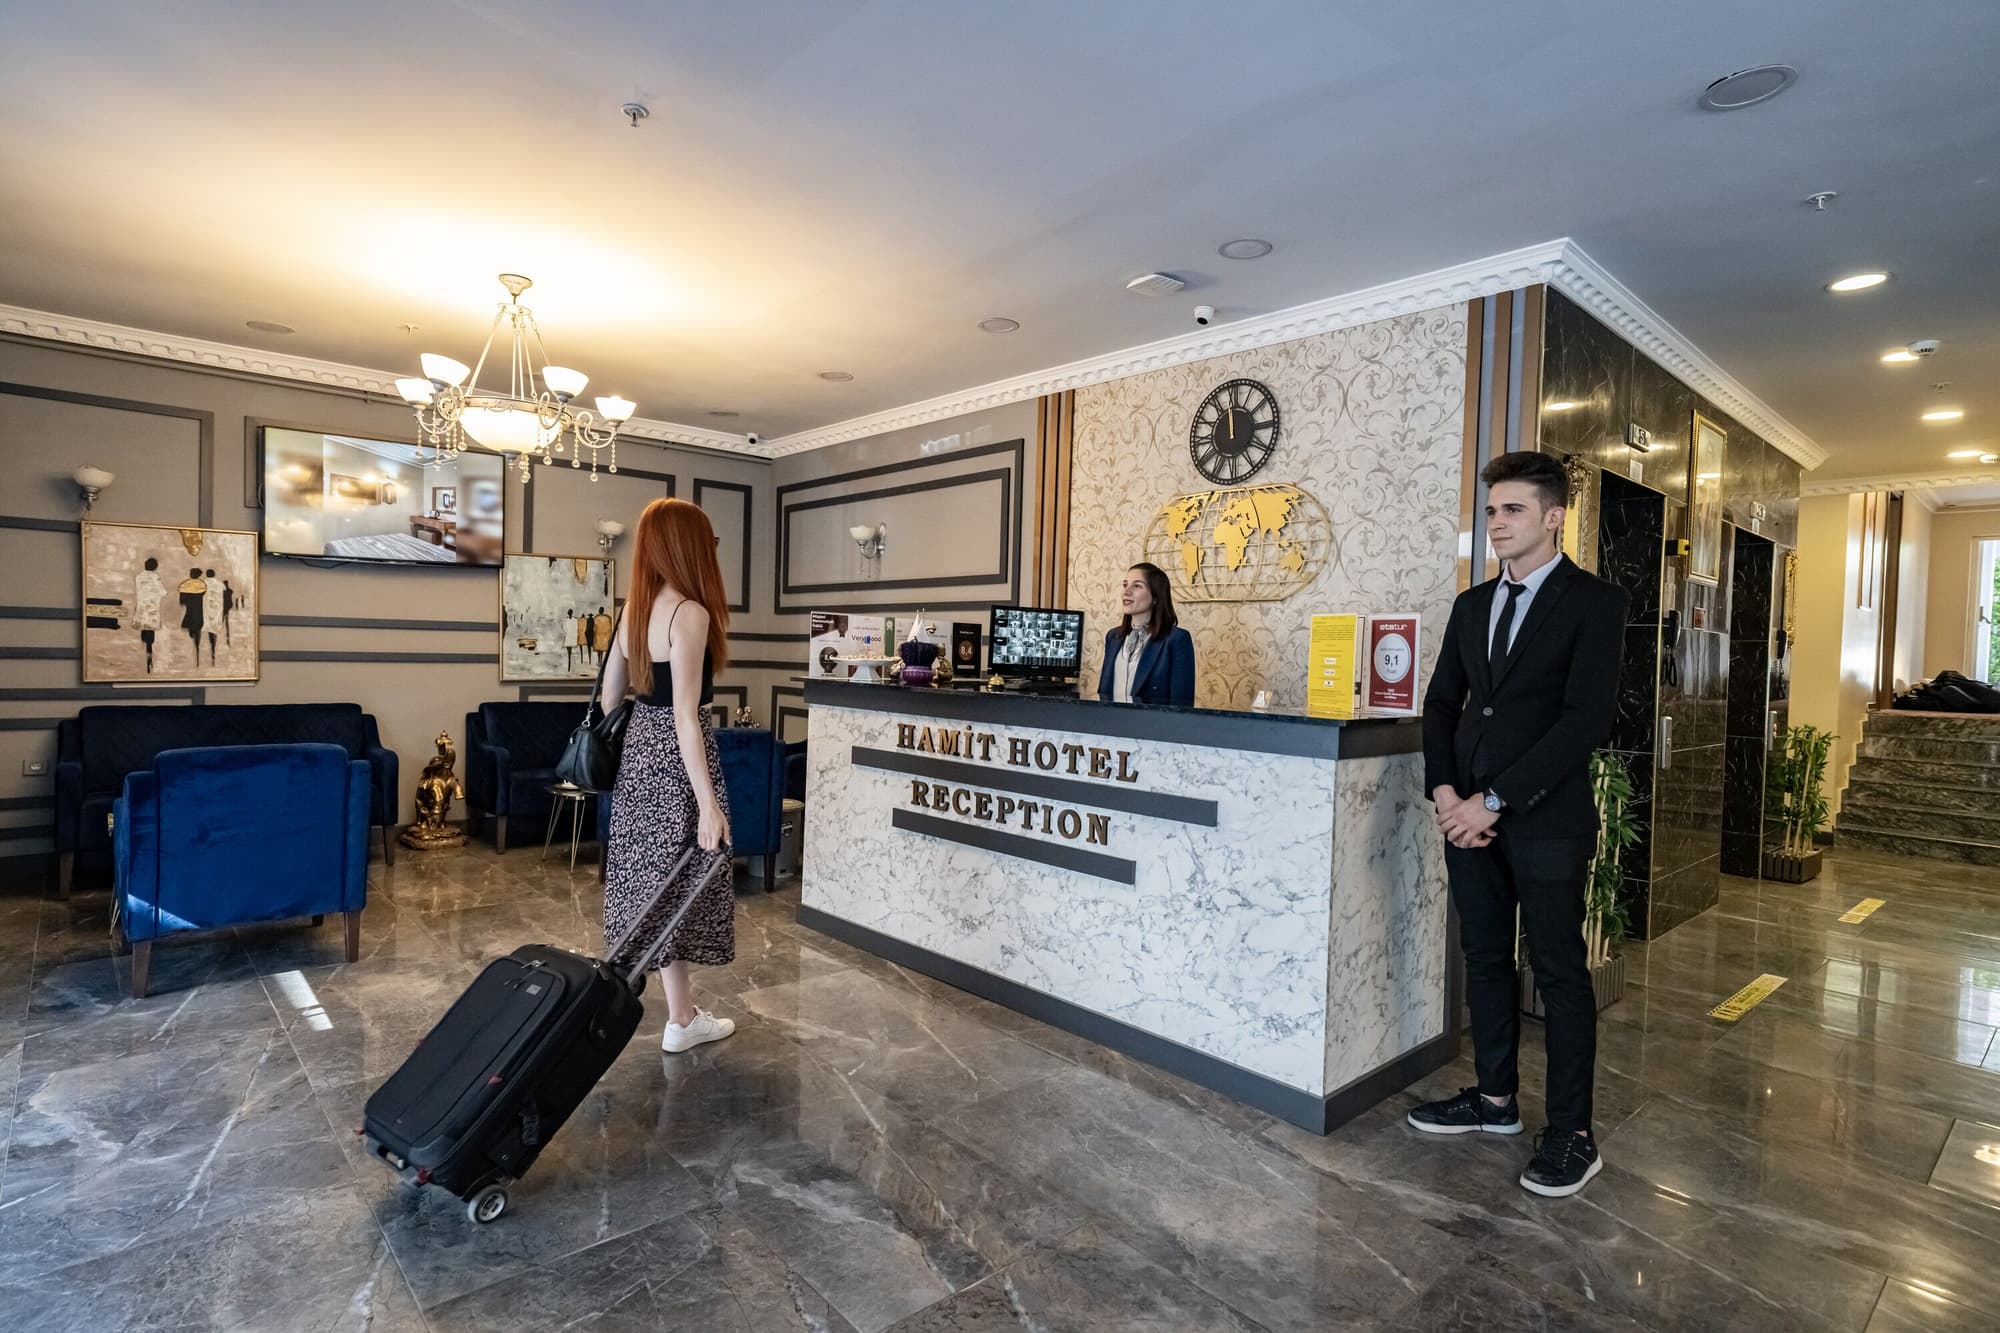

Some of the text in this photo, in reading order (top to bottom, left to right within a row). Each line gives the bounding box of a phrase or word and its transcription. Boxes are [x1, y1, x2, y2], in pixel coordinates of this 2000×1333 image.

[1384, 654, 1399, 667] 9,1
[897, 723, 1139, 783] HAMİT HOTEL
[911, 780, 1111, 846] RECEPTION
